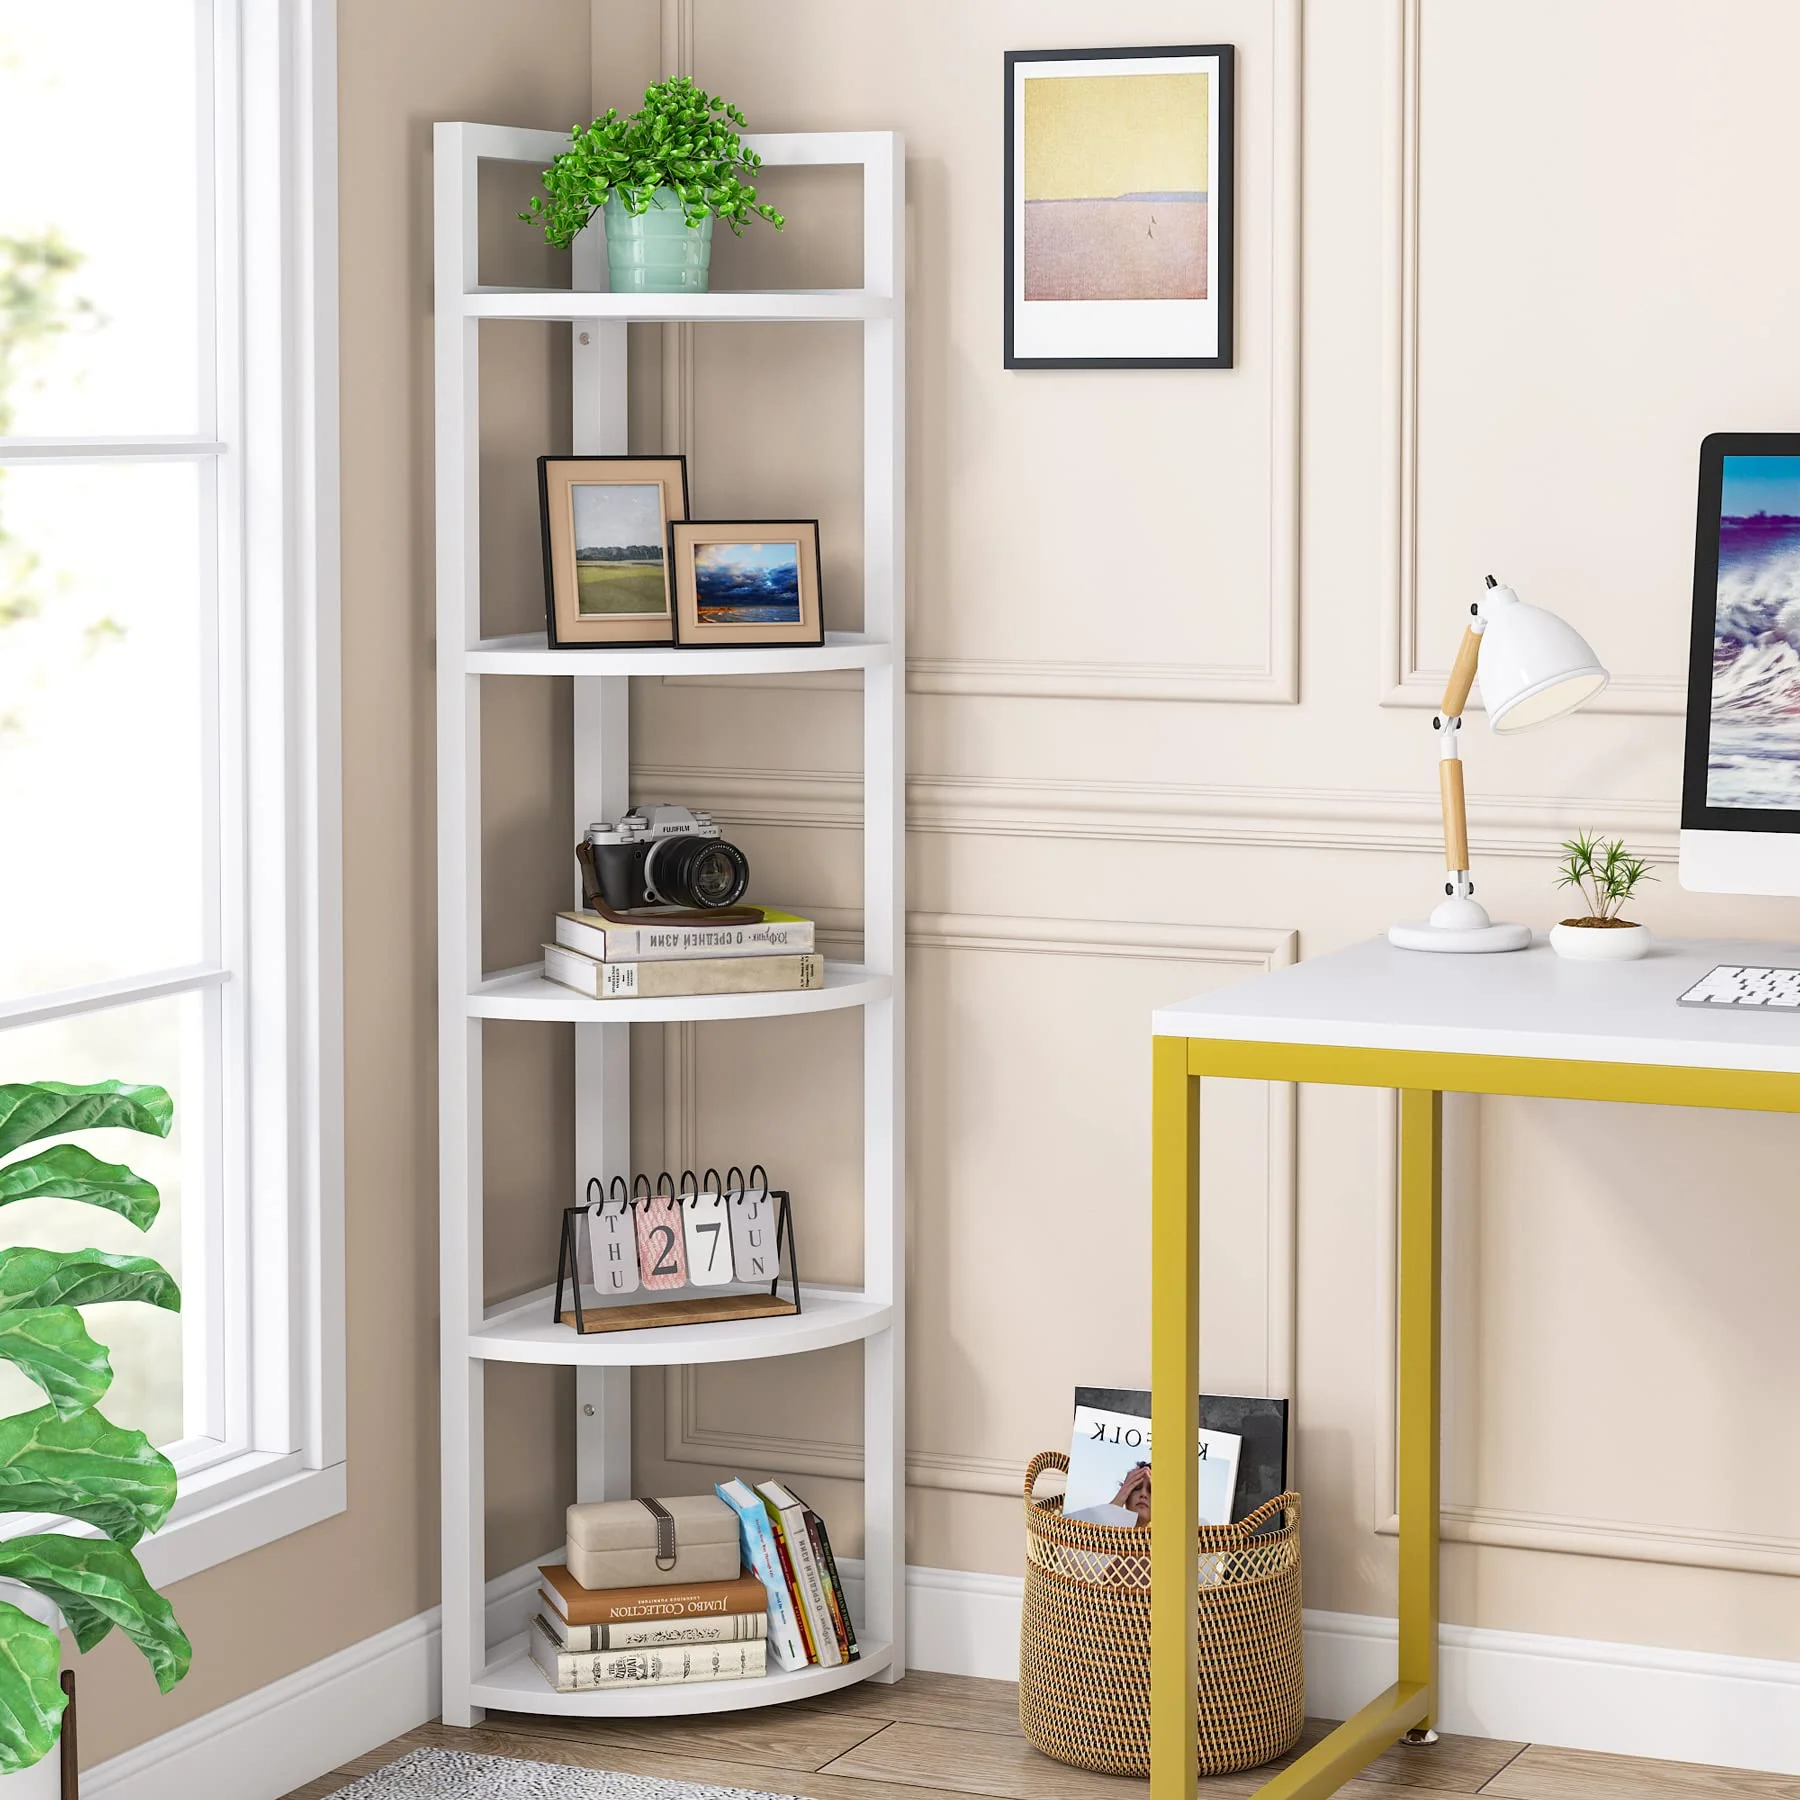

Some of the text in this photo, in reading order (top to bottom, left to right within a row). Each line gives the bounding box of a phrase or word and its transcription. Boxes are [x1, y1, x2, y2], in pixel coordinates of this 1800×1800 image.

[663, 825, 690, 833] FUJIFILM
[650, 934, 678, 947] АЗИИ
[684, 932, 732, 950] СРЕДНЕЙ
[736, 931, 743, 944] О
[605, 1214, 624, 1288] THU
[747, 1202, 765, 1275] JUN
[798, 1540, 810, 1562] АЗИИ
[804, 1565, 820, 1602] СРЕДНЕЙ
[610, 1596, 728, 1618] JUMBO COLLECTION
